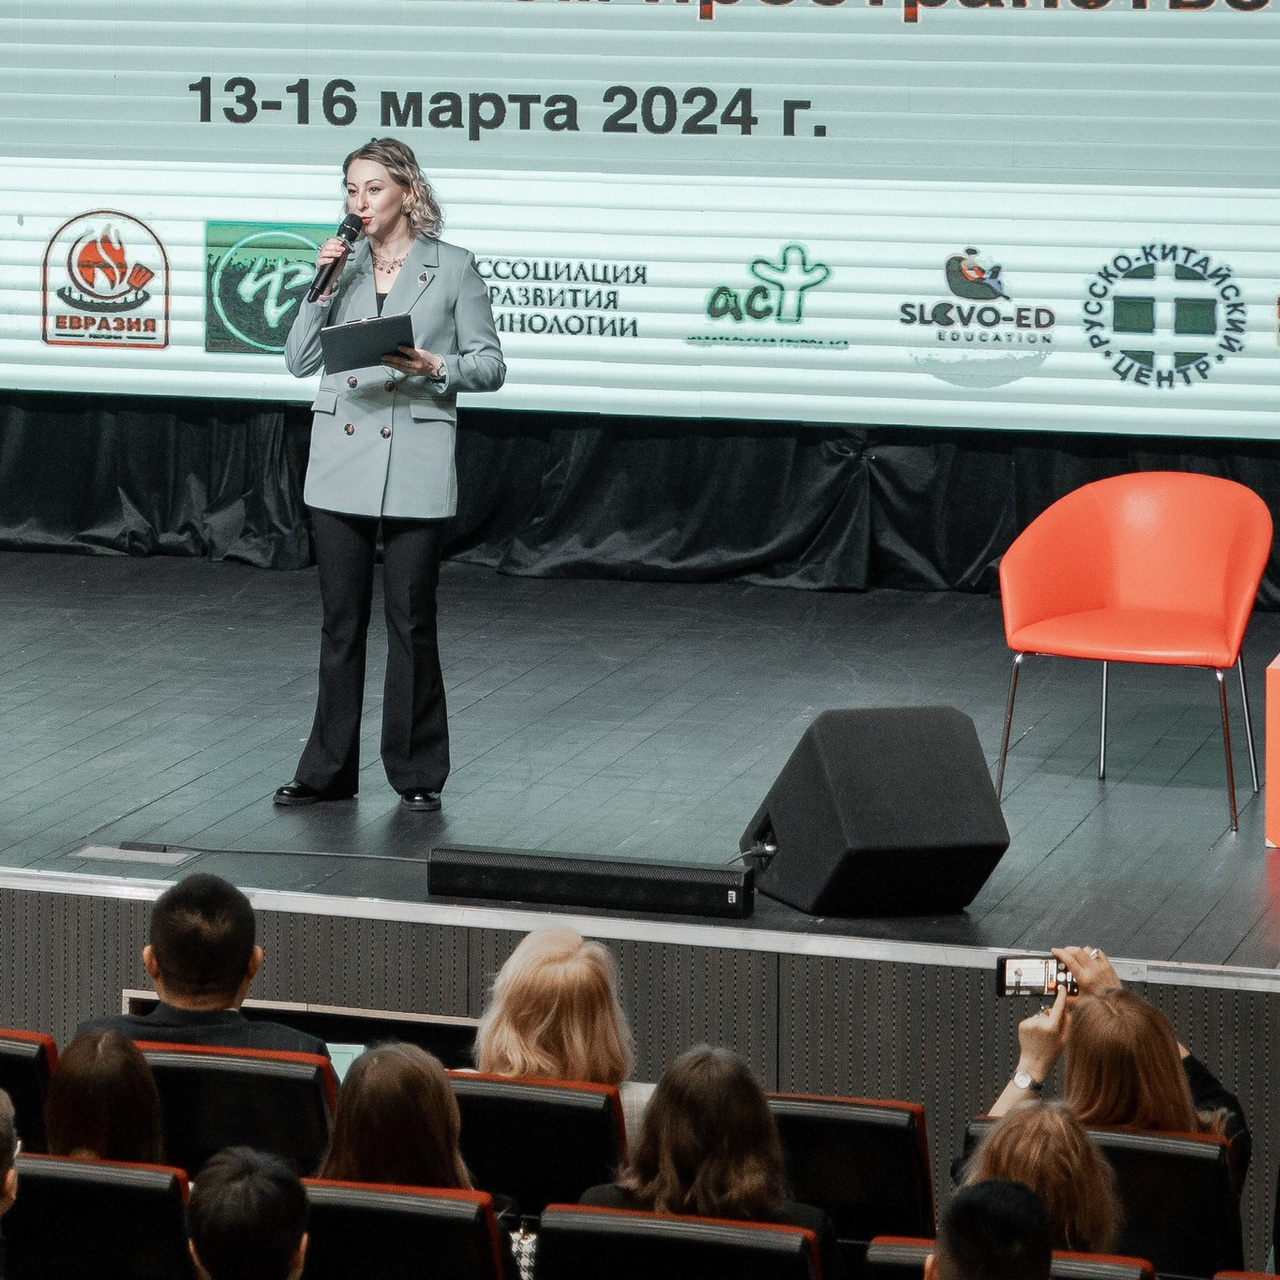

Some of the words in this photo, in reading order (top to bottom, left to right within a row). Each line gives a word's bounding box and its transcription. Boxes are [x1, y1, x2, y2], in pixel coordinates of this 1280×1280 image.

[188, 76, 357, 126] 13-16
[380, 89, 580, 140] марта
[602, 85, 758, 137] 2024
[783, 98, 826, 137] г.
[477, 258, 647, 284] ССОЦИАЦИЯ
[56, 315, 156, 332] ЕВРАЗИЯ
[494, 313, 638, 337] ИНОЛОГИИ
[938, 331, 1051, 344] EDUCATION
[1112, 357, 1210, 387] ЦЕНТР
